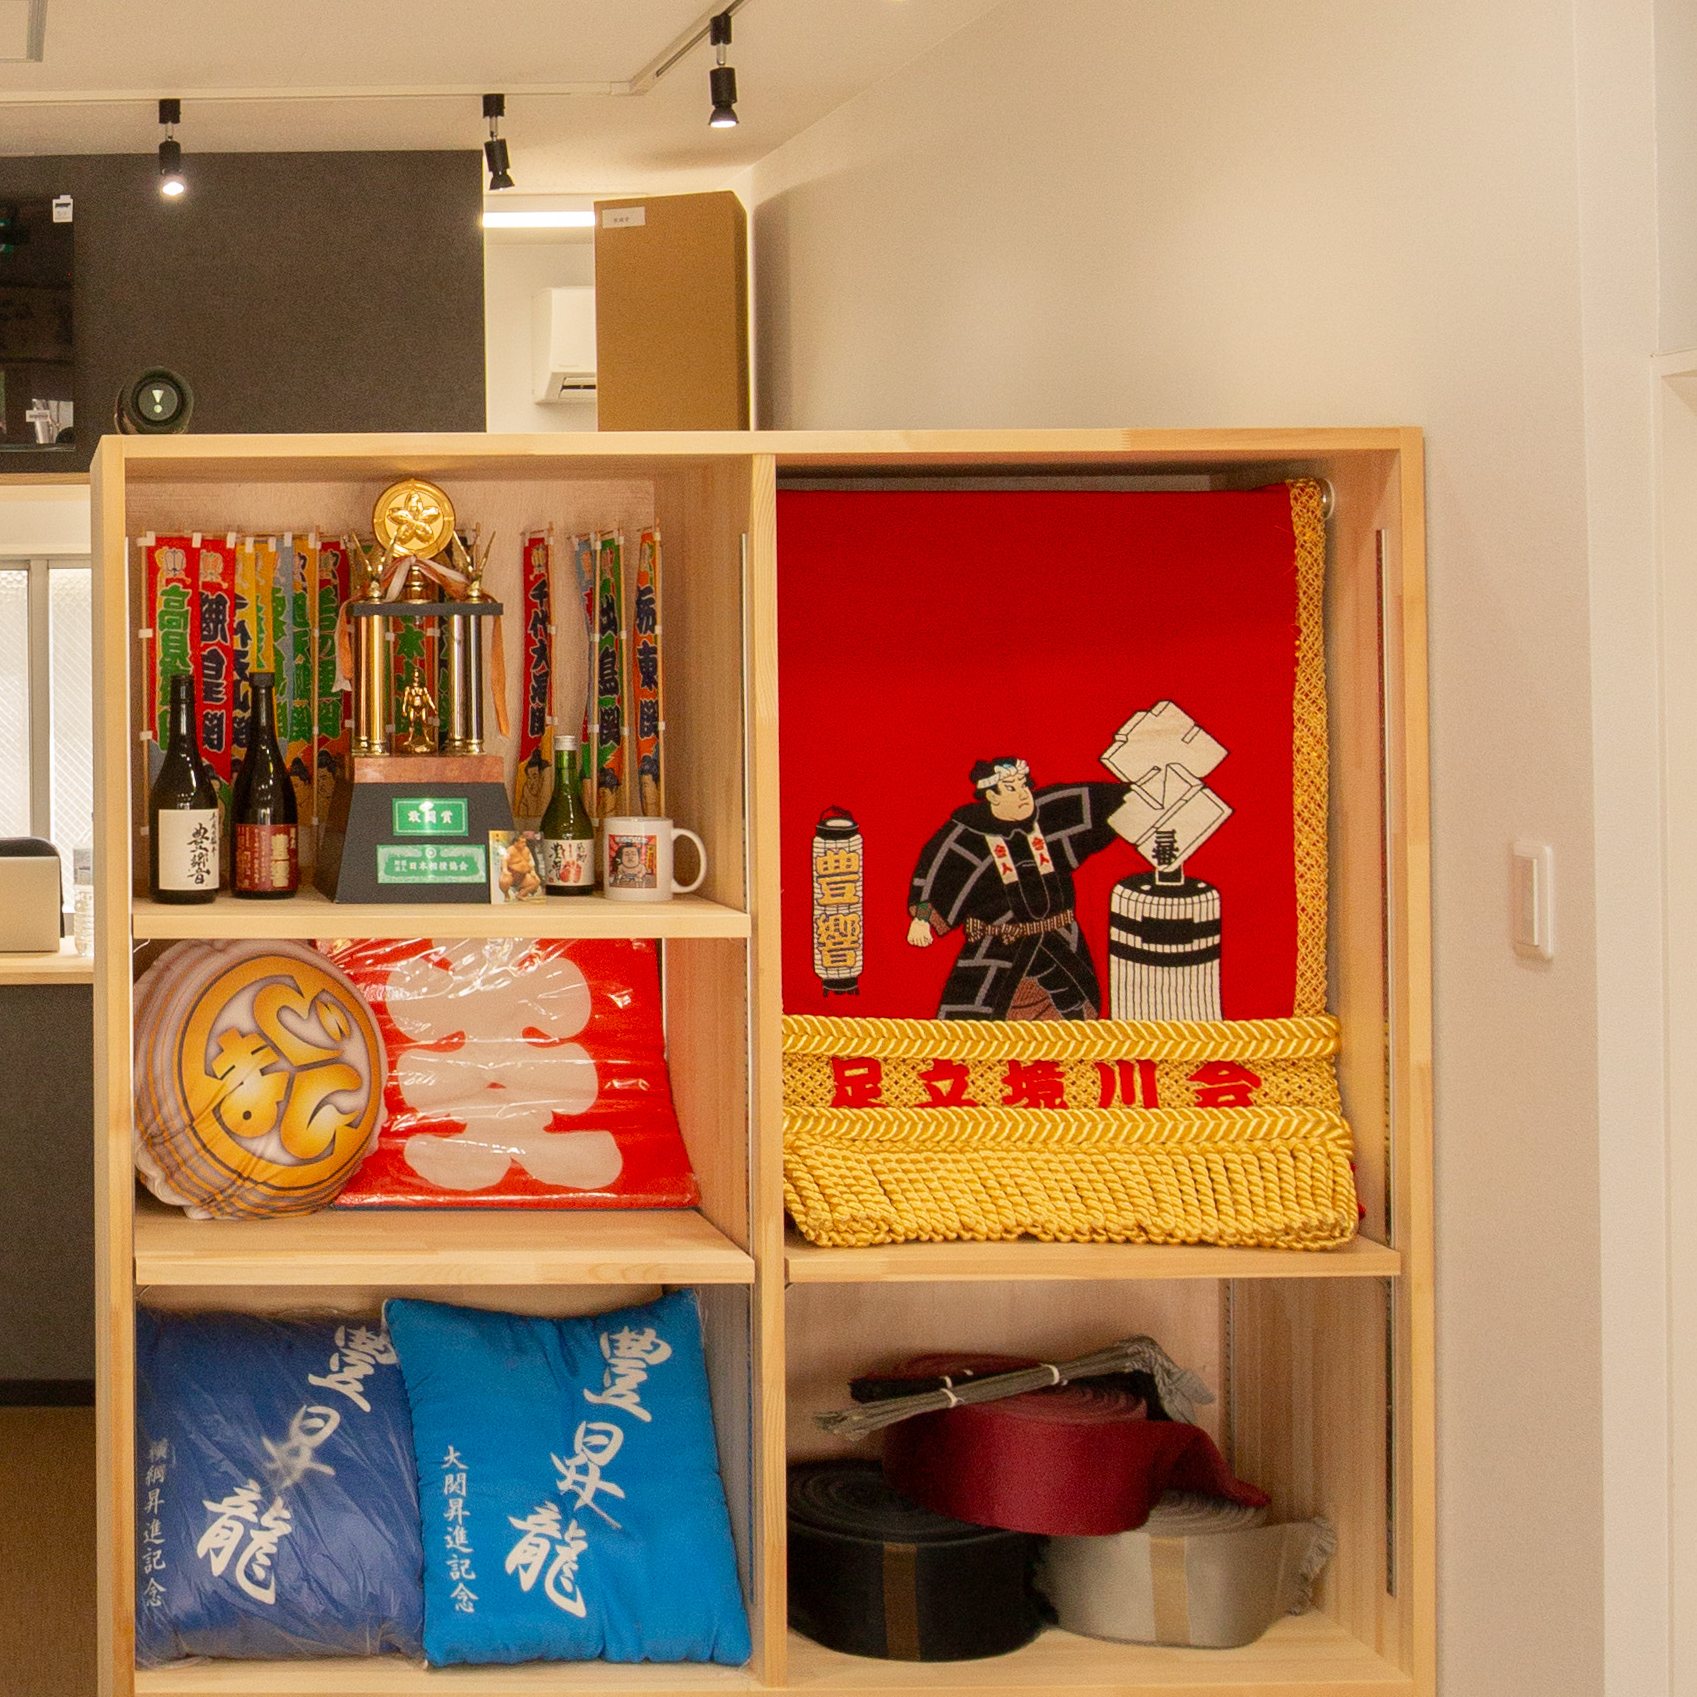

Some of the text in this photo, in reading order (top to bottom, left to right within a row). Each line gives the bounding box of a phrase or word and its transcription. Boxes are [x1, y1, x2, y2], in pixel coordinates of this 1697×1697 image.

[815, 849, 860, 969] 豊響
[830, 1056, 1262, 1110] 足立境川会
[440, 1444, 479, 1614] 大関昇進記念
